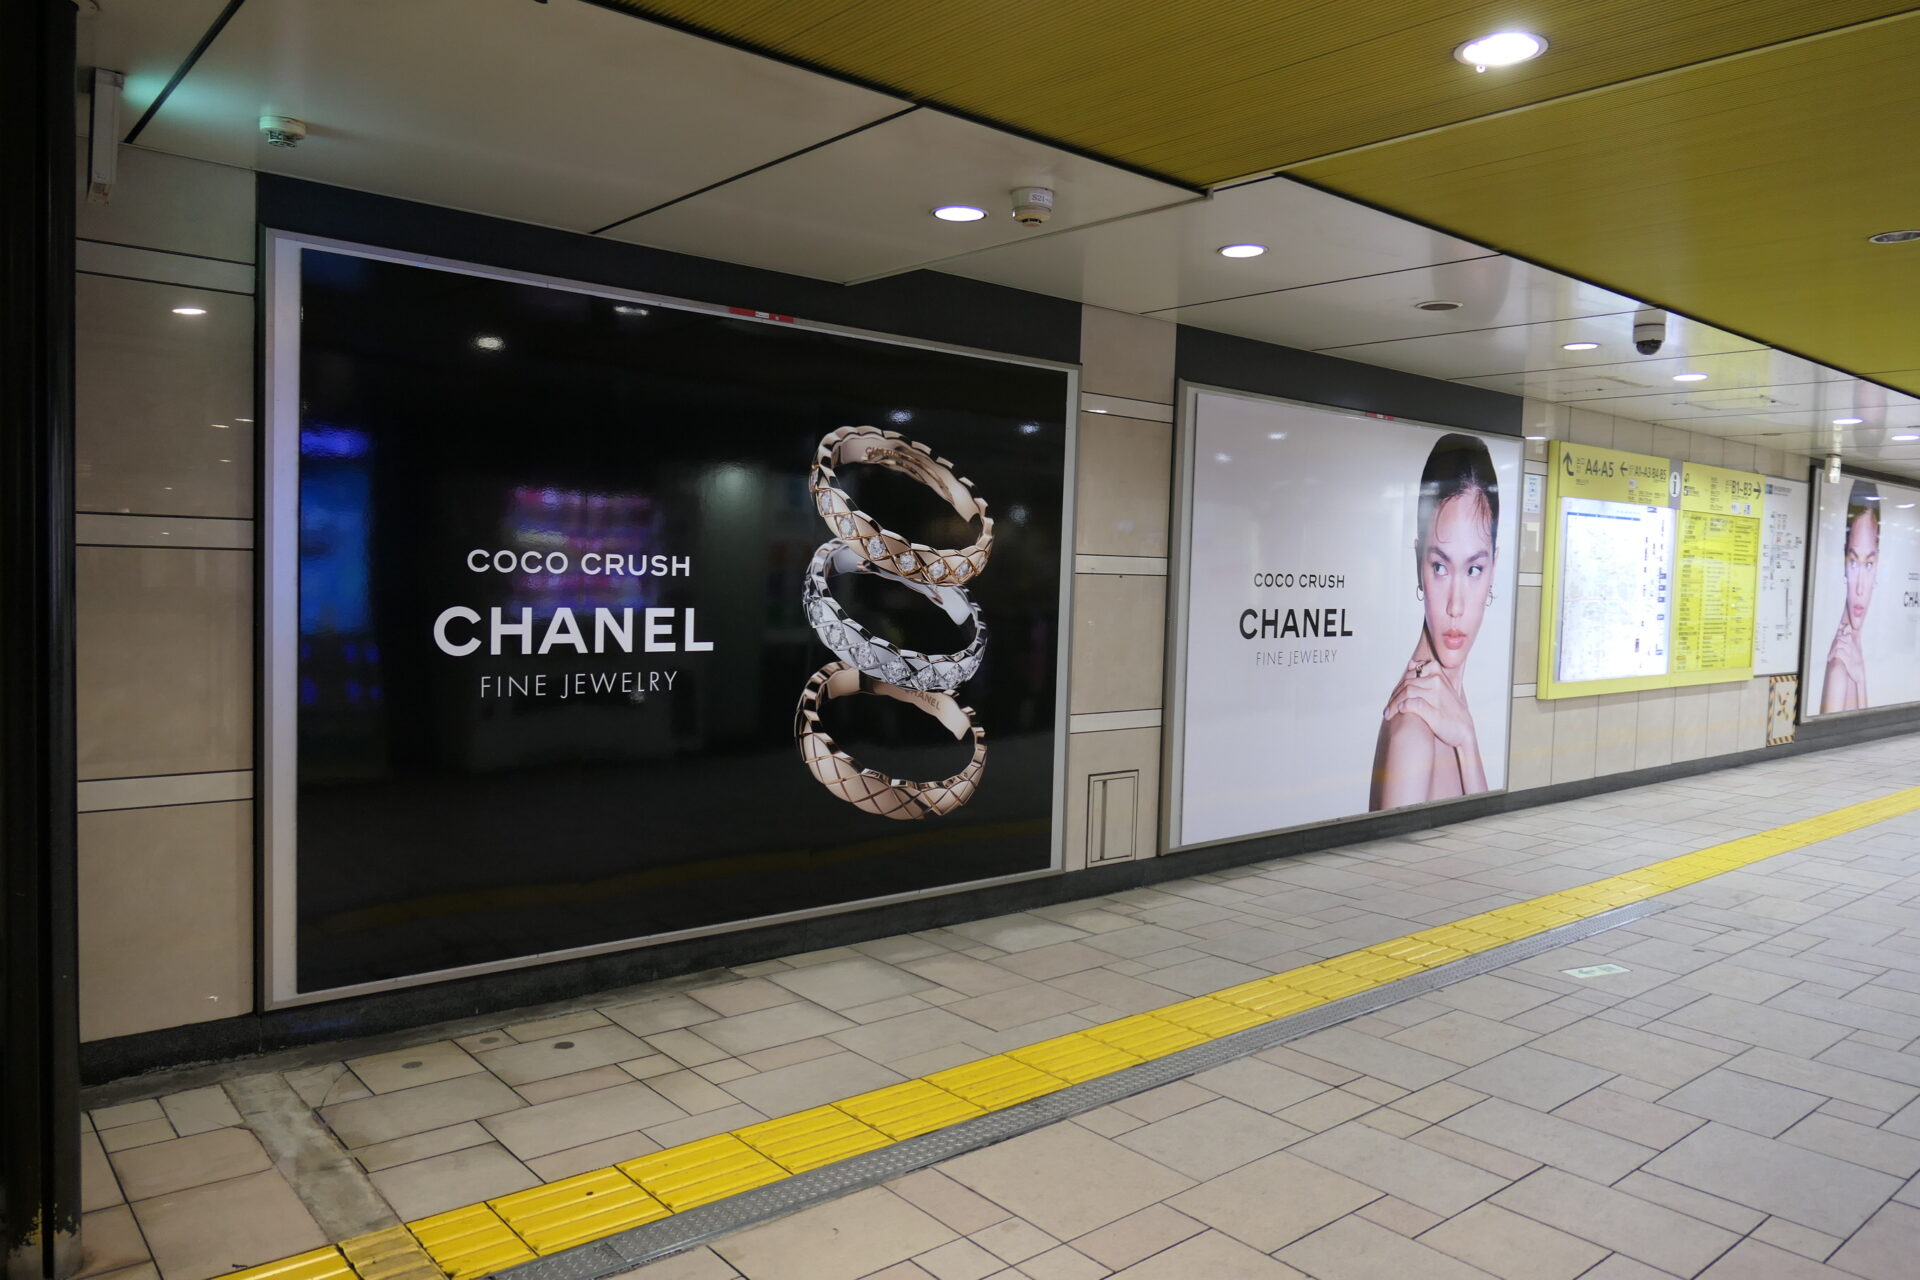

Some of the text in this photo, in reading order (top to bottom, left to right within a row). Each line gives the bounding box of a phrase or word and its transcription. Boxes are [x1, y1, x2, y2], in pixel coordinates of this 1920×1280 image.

[467, 549, 690, 577] COCO CRUSH
[1254, 572, 1345, 589] COCO CRUSH
[433, 606, 714, 657] CHANEL
[1239, 608, 1353, 640] CHANEL
[1256, 649, 1337, 667] FINE JEWELRY
[481, 670, 678, 699] FINE JEWELRY
[905, 689, 941, 710] HANEL
